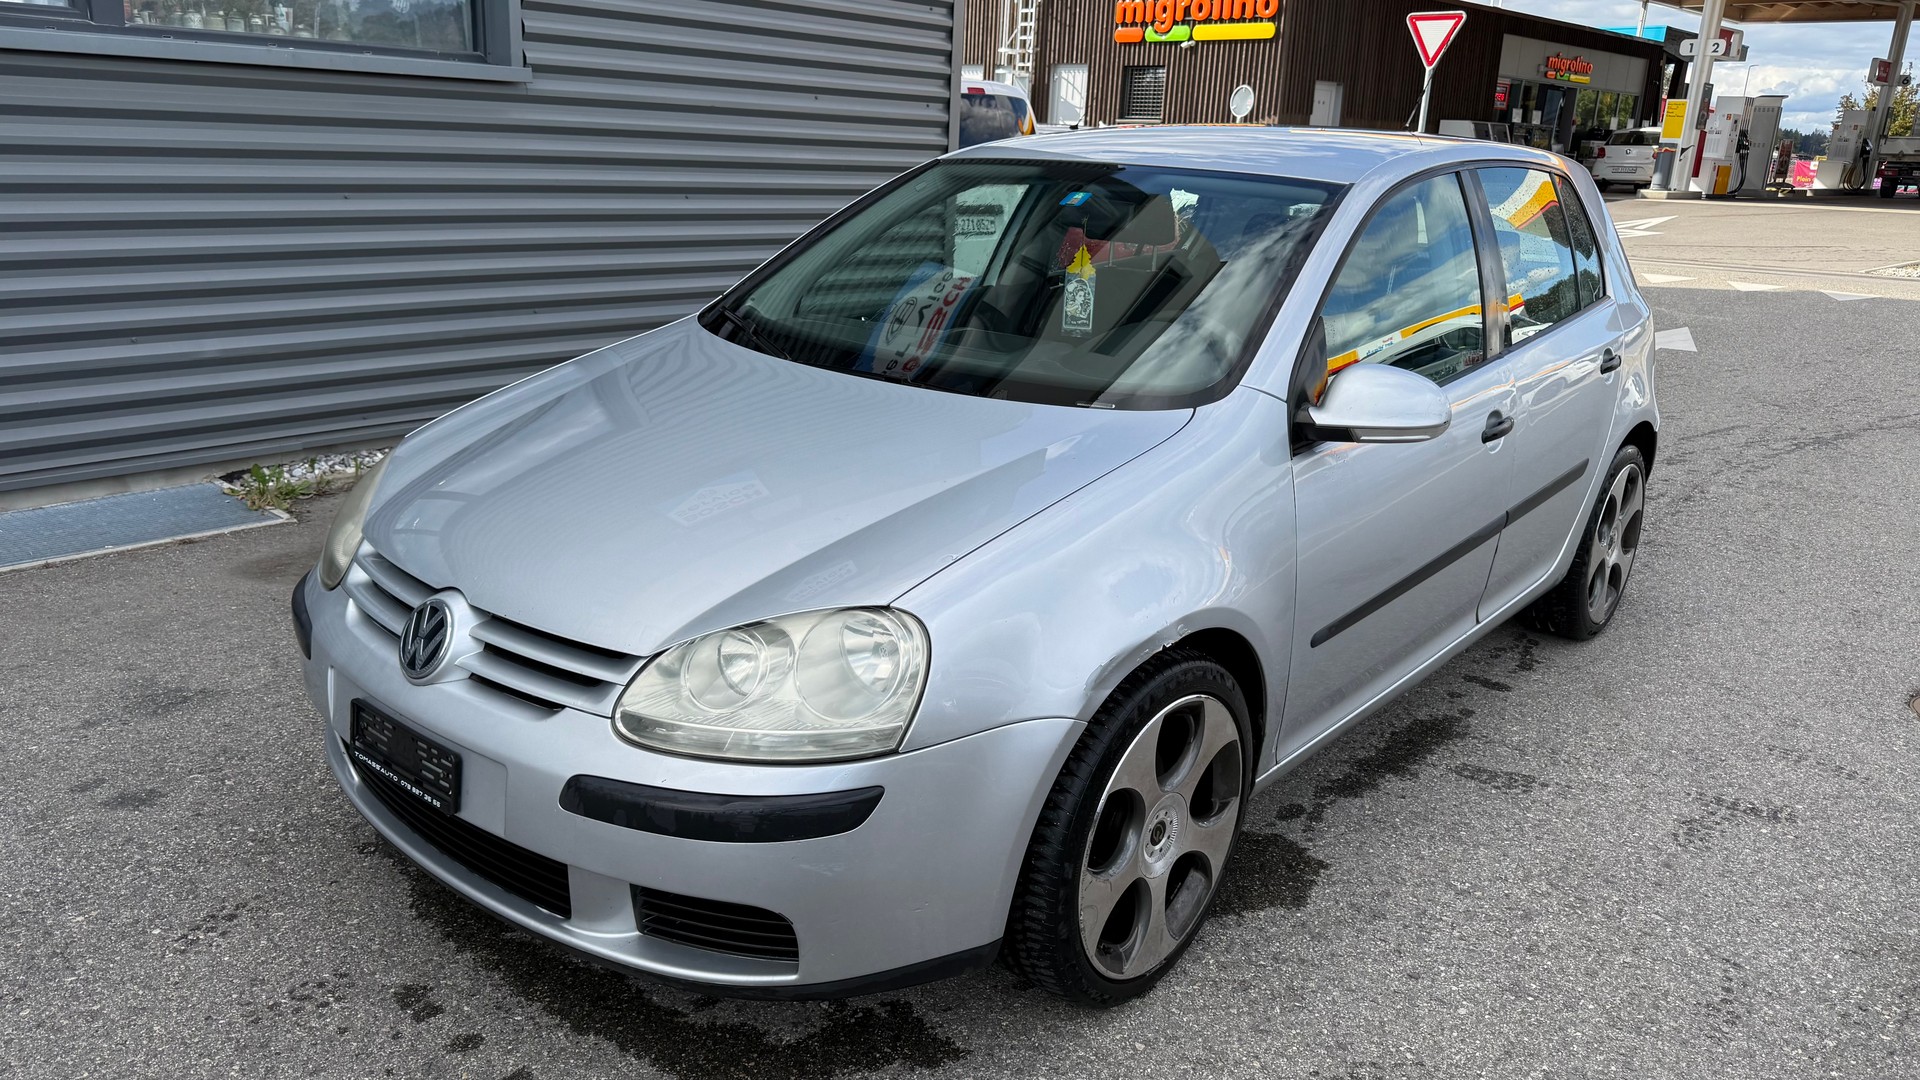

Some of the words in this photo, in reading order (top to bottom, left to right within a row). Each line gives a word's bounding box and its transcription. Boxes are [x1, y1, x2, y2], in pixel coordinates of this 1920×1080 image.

[1115, 0, 1279, 33] migrolino
[1688, 43, 1694, 53] 1
[1711, 42, 1720, 53] 2
[1547, 52, 1594, 76] migrolino
[1901, 76, 1909, 85] 6
